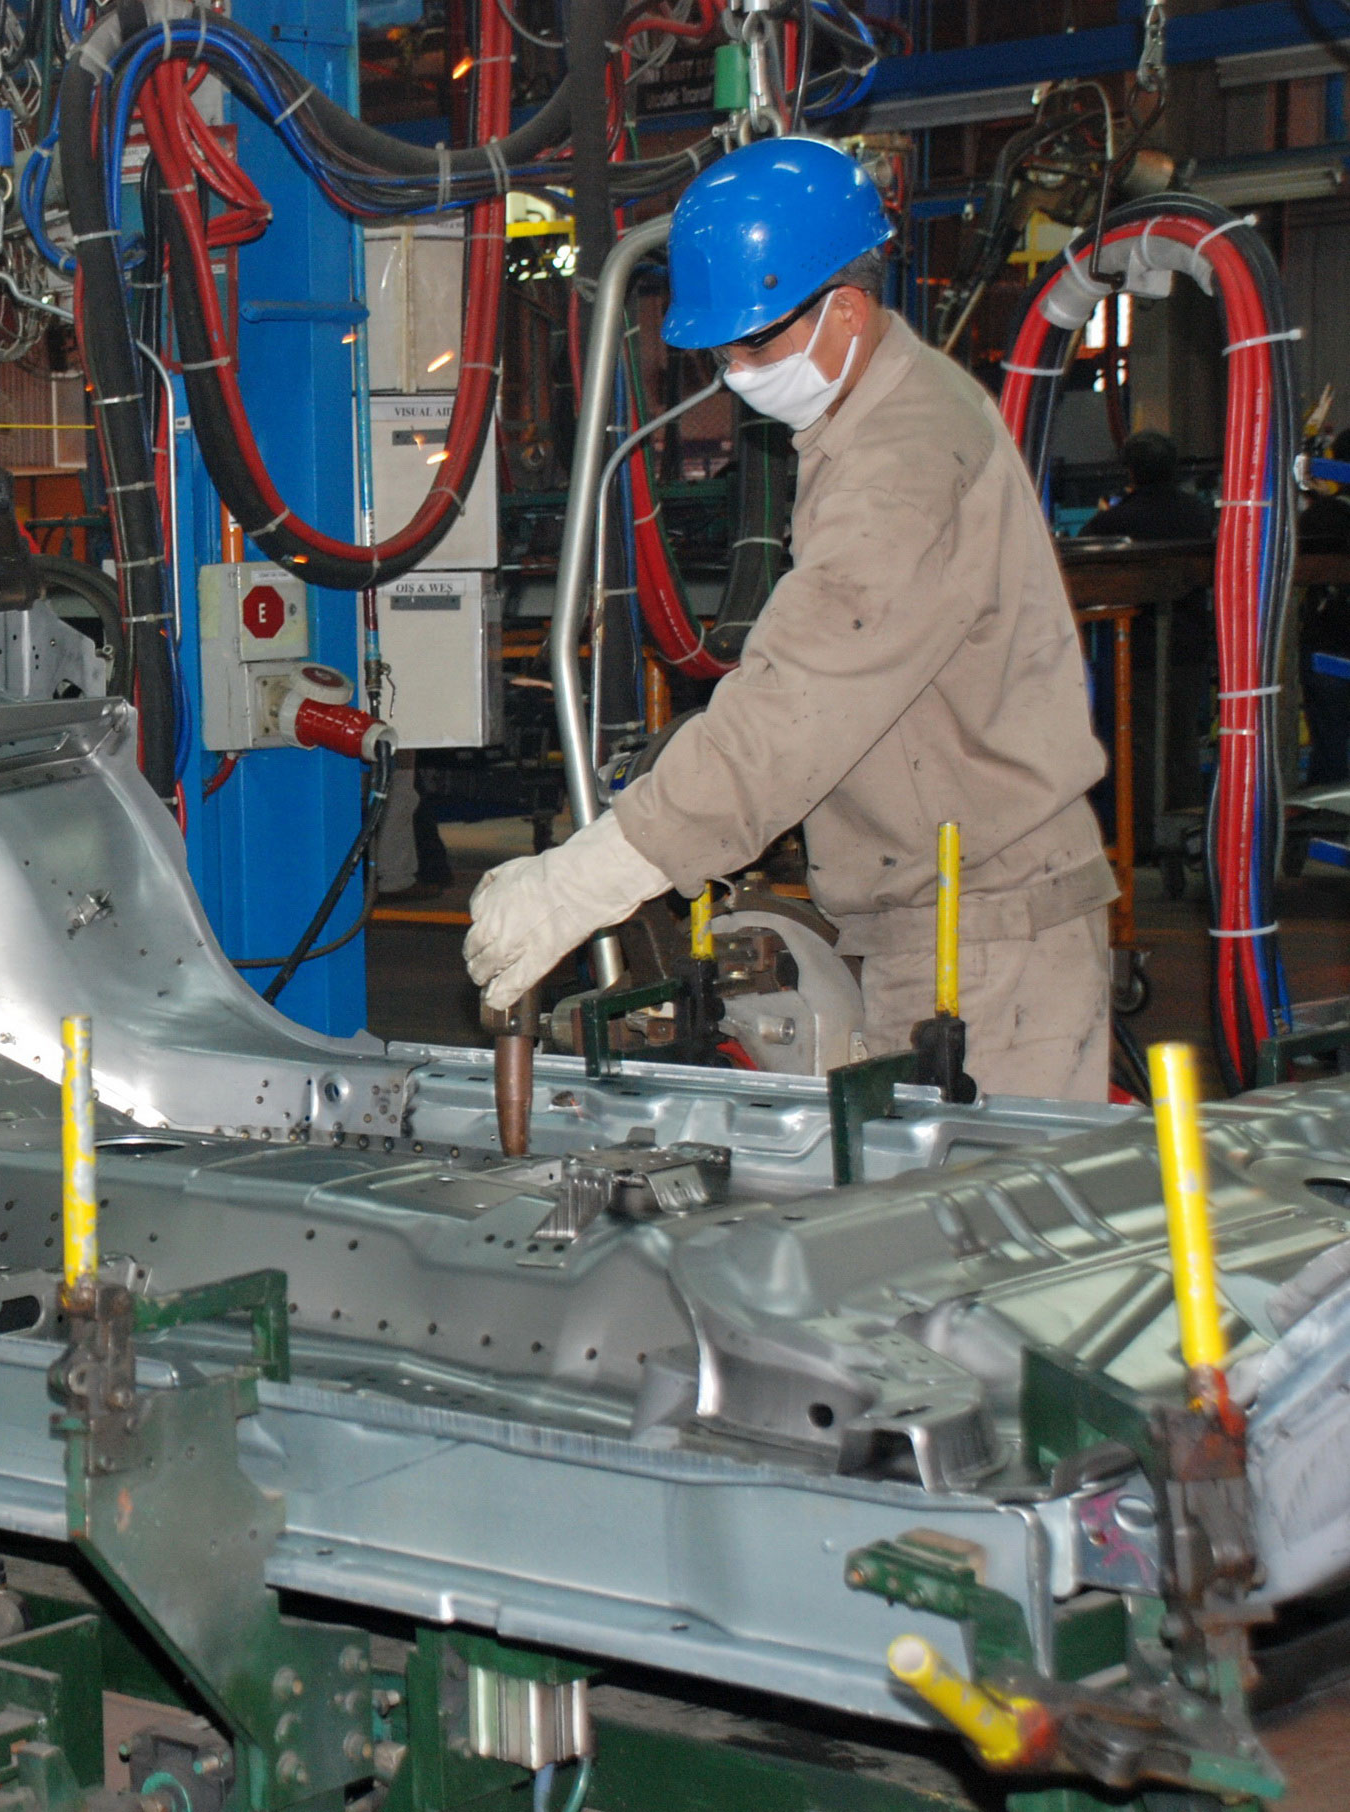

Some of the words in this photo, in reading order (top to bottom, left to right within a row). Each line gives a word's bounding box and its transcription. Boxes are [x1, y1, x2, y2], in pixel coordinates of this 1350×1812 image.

[395, 407, 432, 417] VISUAL
[395, 583, 415, 593] OIS
[417, 583, 425, 593] &
[258, 602, 267, 624] E
